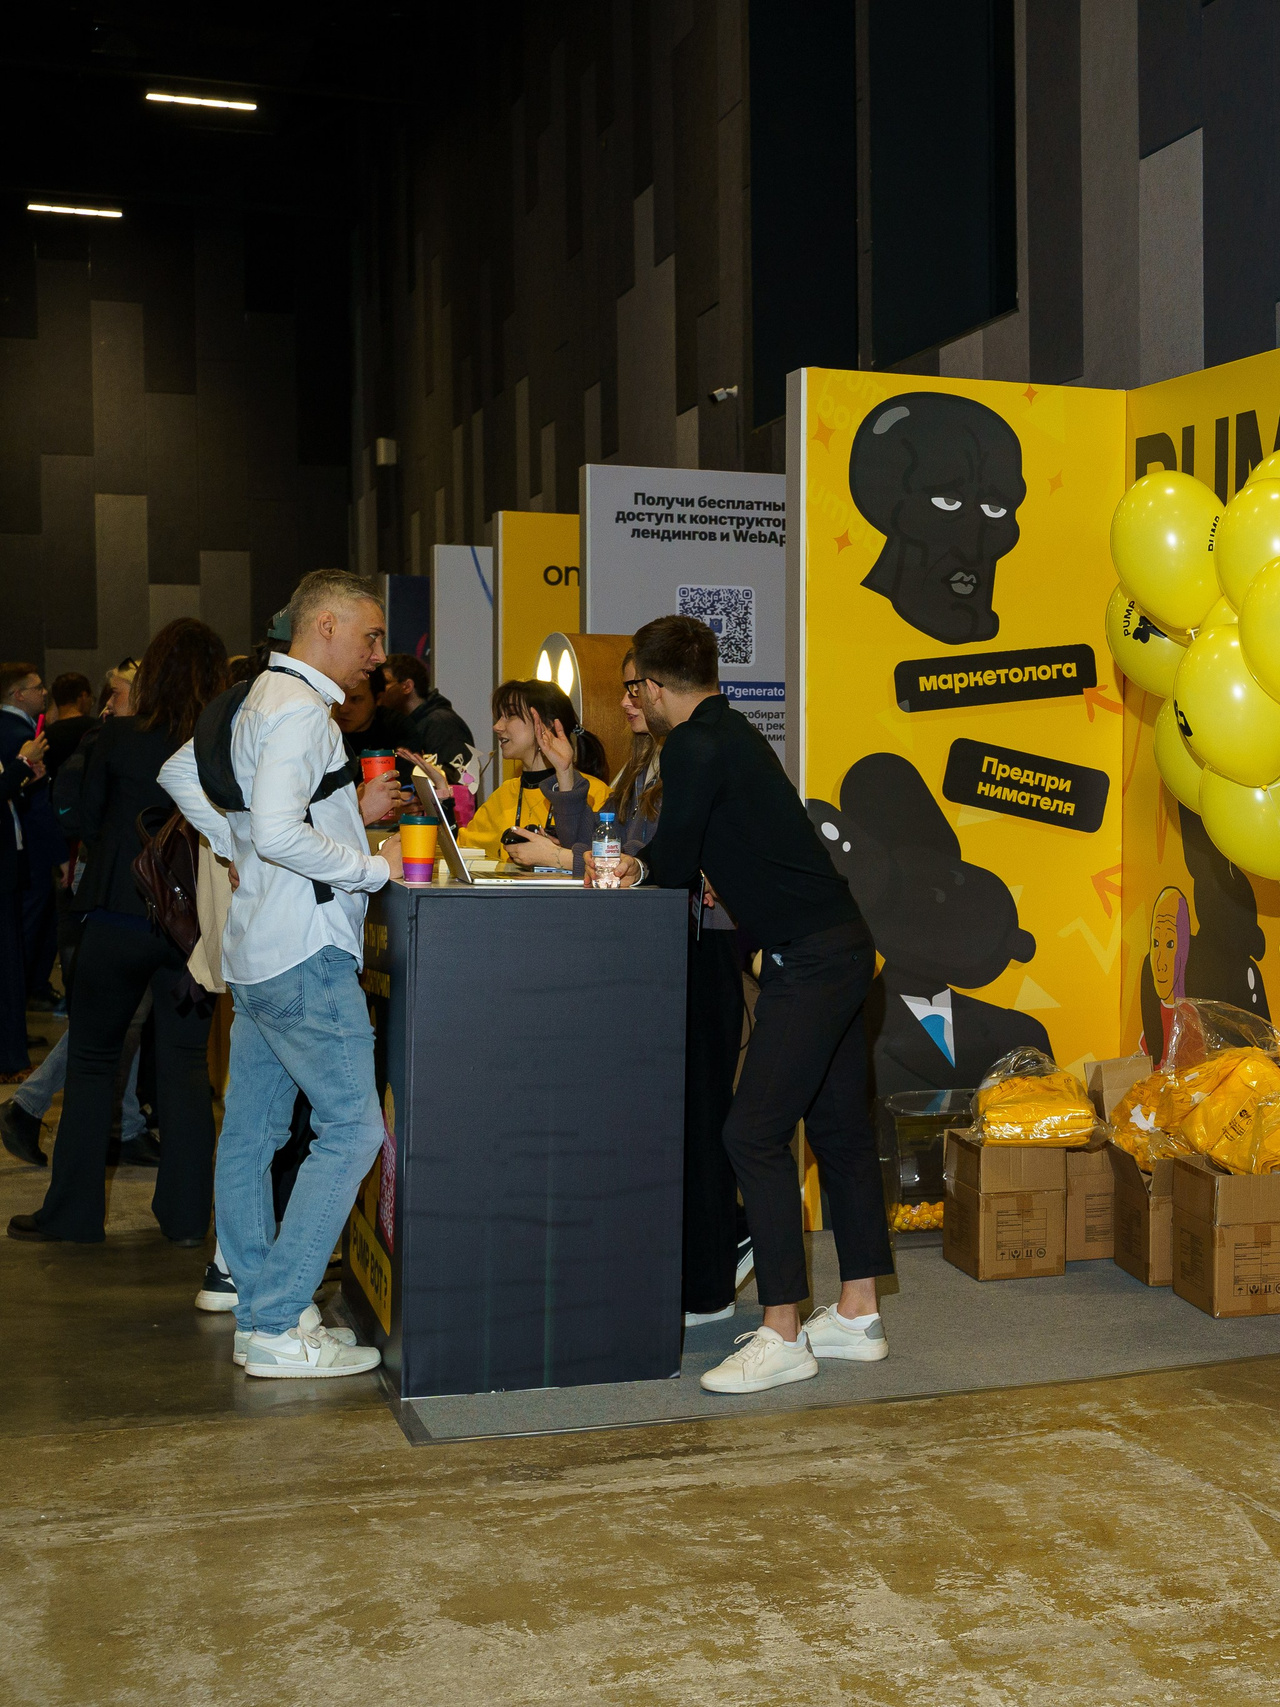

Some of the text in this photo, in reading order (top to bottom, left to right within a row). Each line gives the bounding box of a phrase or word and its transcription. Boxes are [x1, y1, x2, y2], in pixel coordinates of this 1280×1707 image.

[615, 510, 674, 526] доступ
[677, 513, 687, 524] к
[633, 492, 695, 510] Получи
[630, 527, 717, 542] лендингов
[720, 532, 730, 542] и
[1123, 600, 1136, 637] PUMP
[918, 662, 1078, 694] маркетолога
[981, 755, 1073, 793] Предпри
[976, 781, 1077, 817] нимателя
[353, 1220, 370, 1275] PUMP
